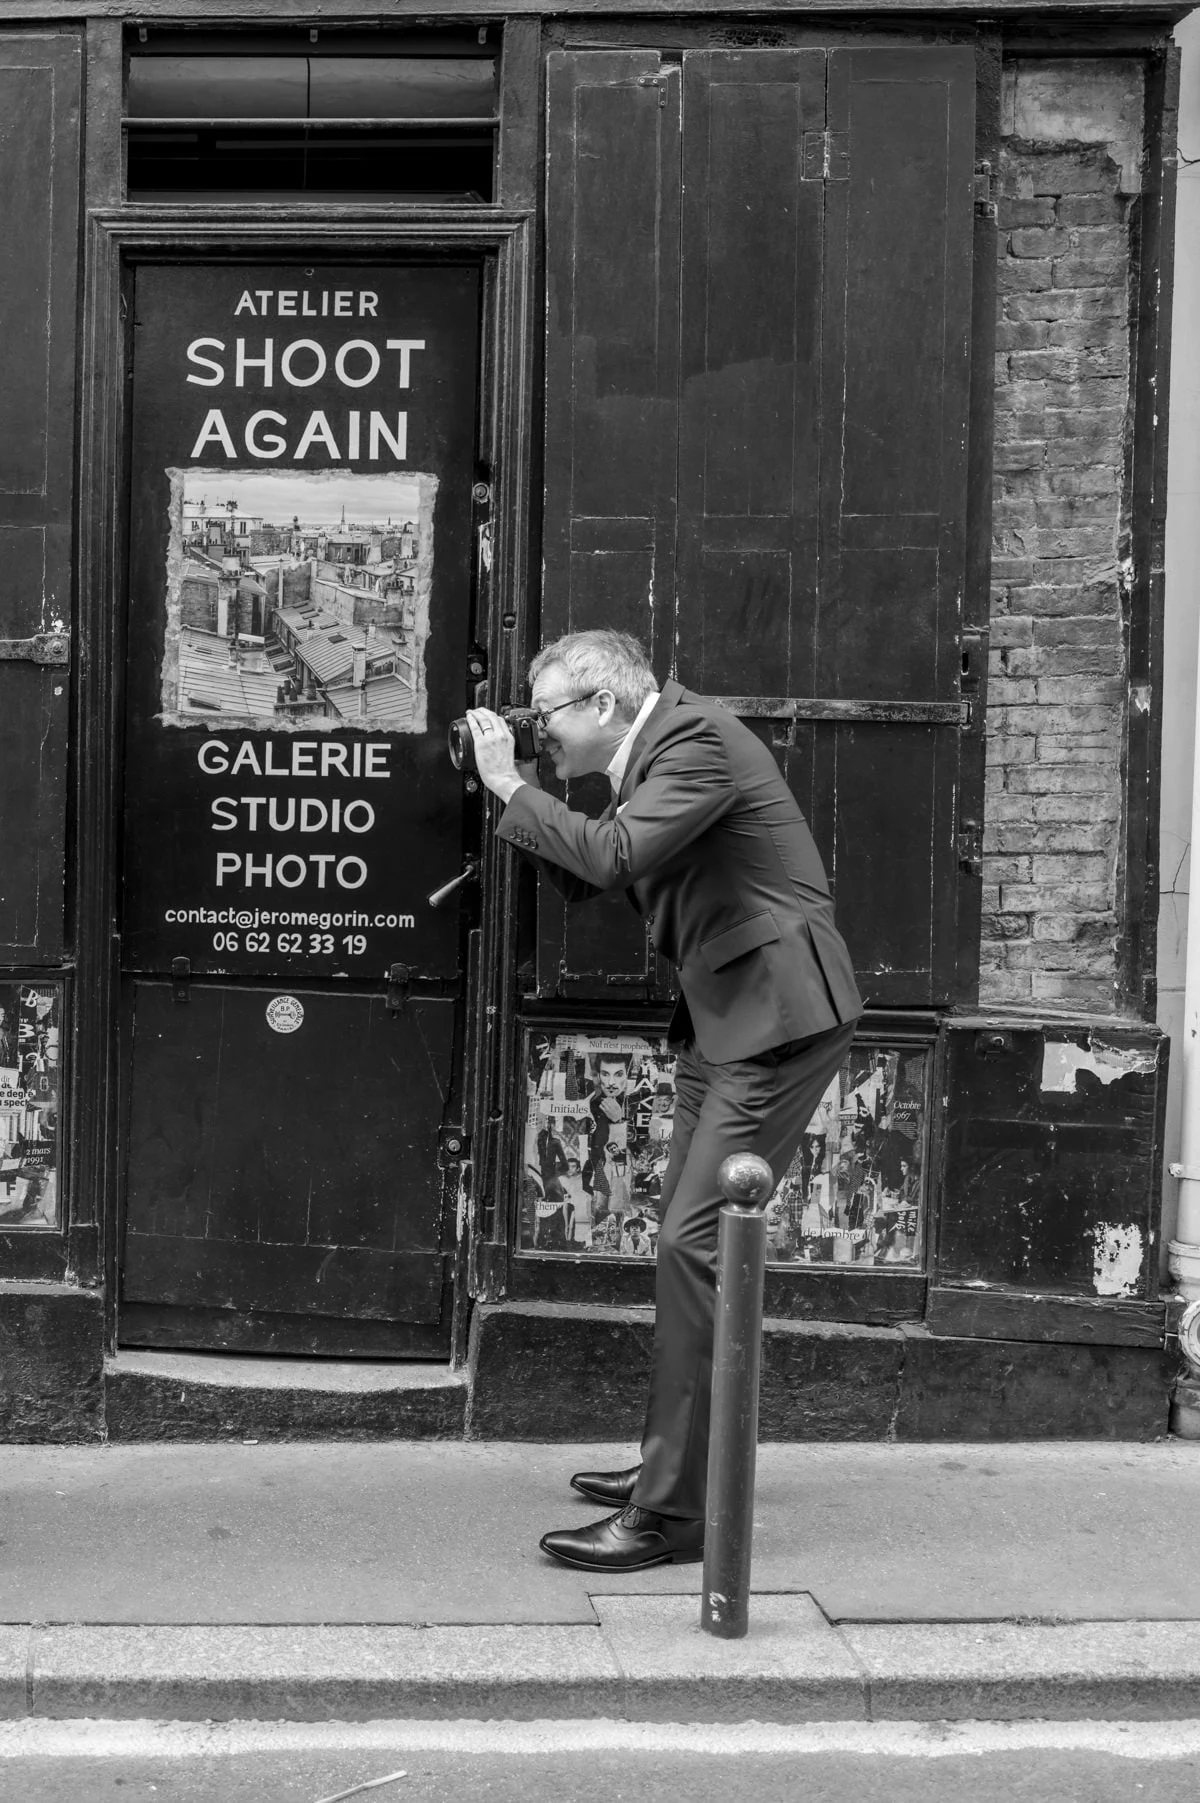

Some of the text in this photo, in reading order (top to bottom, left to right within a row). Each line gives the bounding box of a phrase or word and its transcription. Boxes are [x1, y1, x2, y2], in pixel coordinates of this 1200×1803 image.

[233, 290, 379, 317] ATELIER
[185, 337, 426, 389] SHOOT
[190, 408, 408, 461] AGAIN
[197, 739, 392, 778] GALERIE
[211, 796, 375, 833] STUDIO
[216, 852, 368, 889] PHOTO
[165, 907, 415, 930] contact@jeromegorin.com
[213, 931, 367, 955] 06 62 62 33 19
[550, 1104, 589, 1114] Initiales
